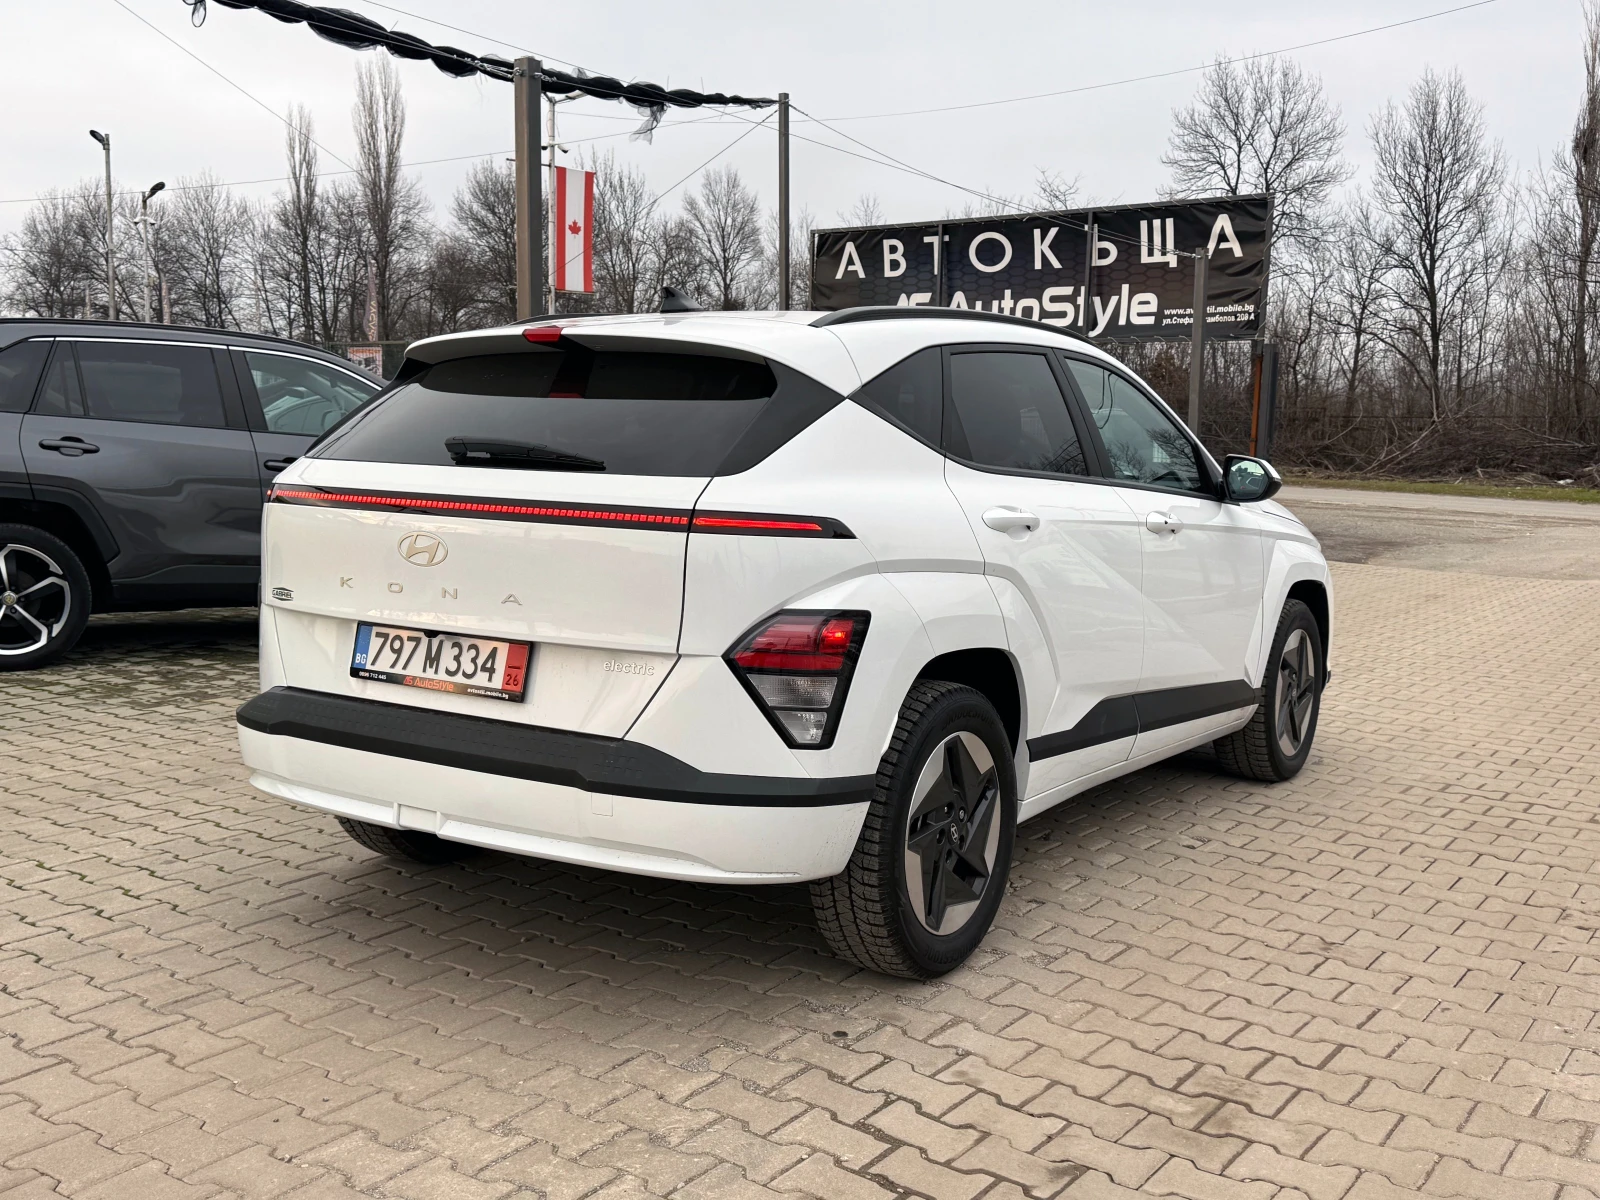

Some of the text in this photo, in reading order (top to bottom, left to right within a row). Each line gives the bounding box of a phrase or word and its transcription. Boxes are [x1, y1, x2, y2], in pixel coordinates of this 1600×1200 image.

[1163, 303, 1255, 316] www.avtil.mobile.bg
[1162, 316, 1194, 327] ул.Стефа
[1206, 314, 1235, 323] амболов
[340, 576, 523, 606] KONA
[355, 653, 367, 664] BG
[603, 659, 655, 676] electric
[414, 678, 454, 691] AutoStyle
[505, 673, 519, 687] 26
